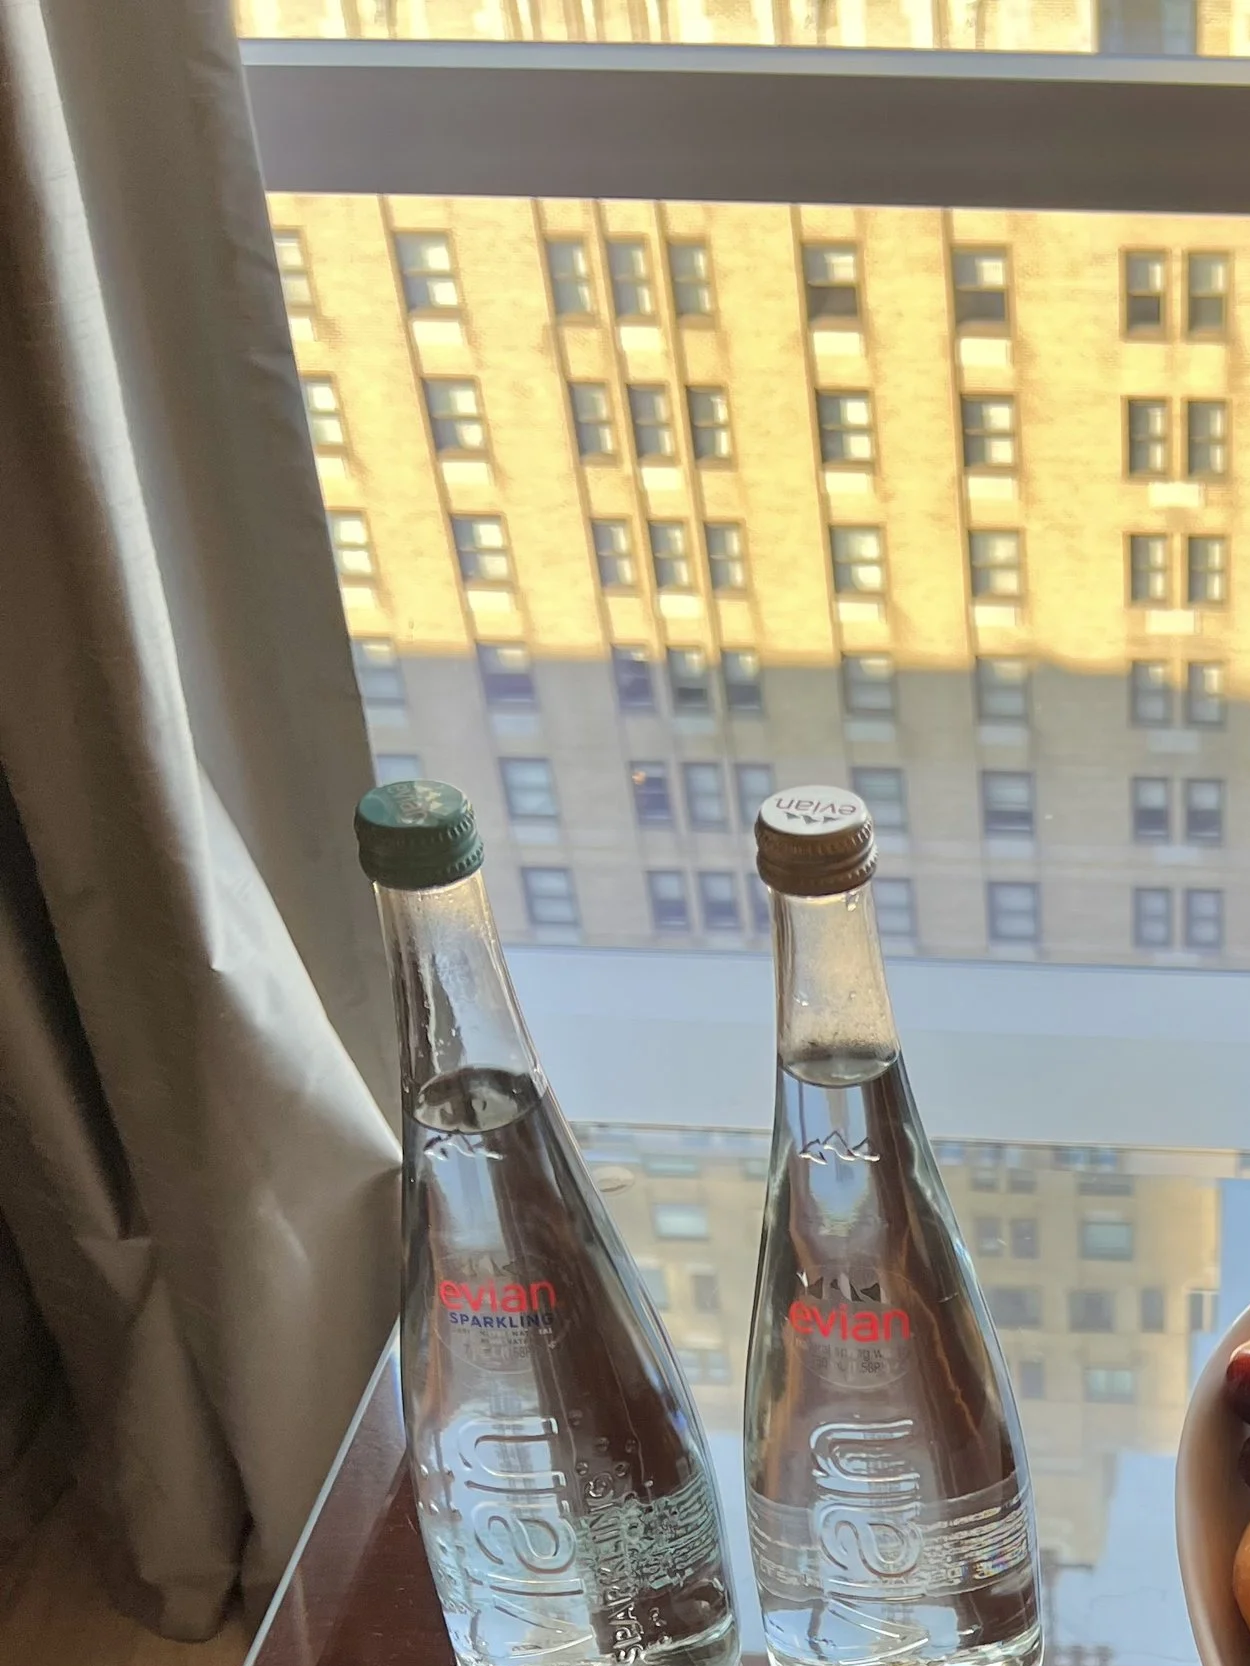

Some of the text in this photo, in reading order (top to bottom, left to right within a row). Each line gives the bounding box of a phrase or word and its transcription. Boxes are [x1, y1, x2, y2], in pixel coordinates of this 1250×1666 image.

[775, 797, 857, 816] evian
[438, 1277, 558, 1313] evian
[449, 1311, 555, 1329] SPARKLING
[788, 1298, 911, 1343] evian
